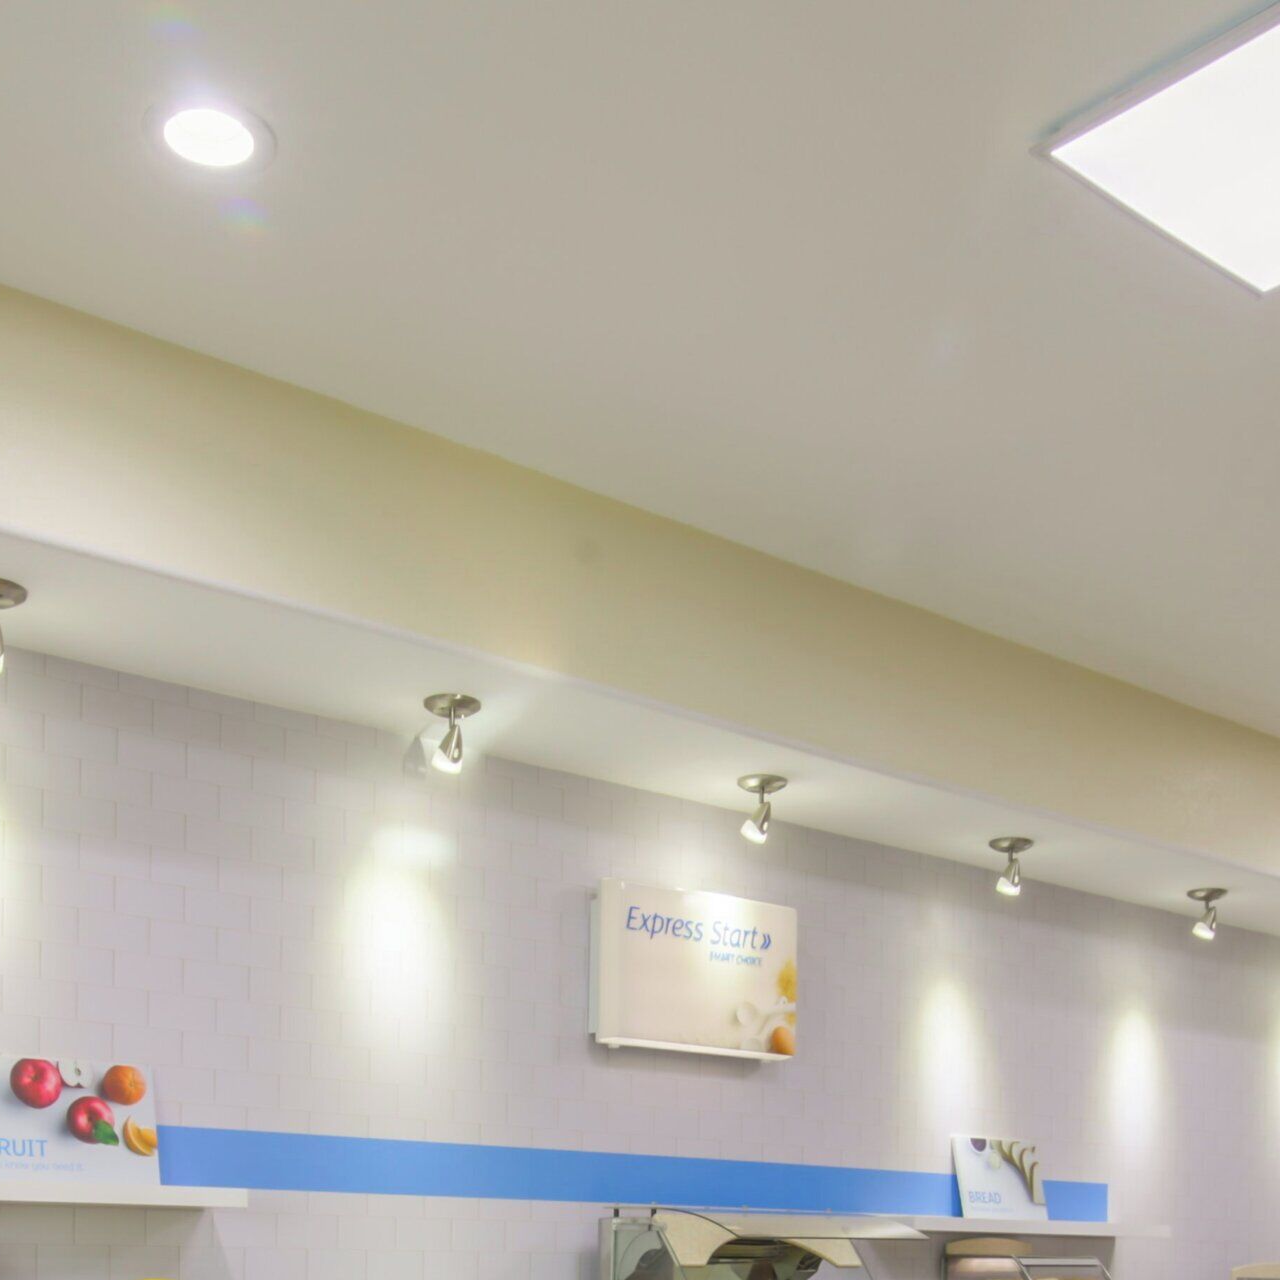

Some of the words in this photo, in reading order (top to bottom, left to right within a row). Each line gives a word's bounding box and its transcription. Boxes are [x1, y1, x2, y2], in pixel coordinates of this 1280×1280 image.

[626, 906, 703, 942] Express
[710, 921, 757, 949] Start
[969, 1190, 1002, 1204] BREAD
